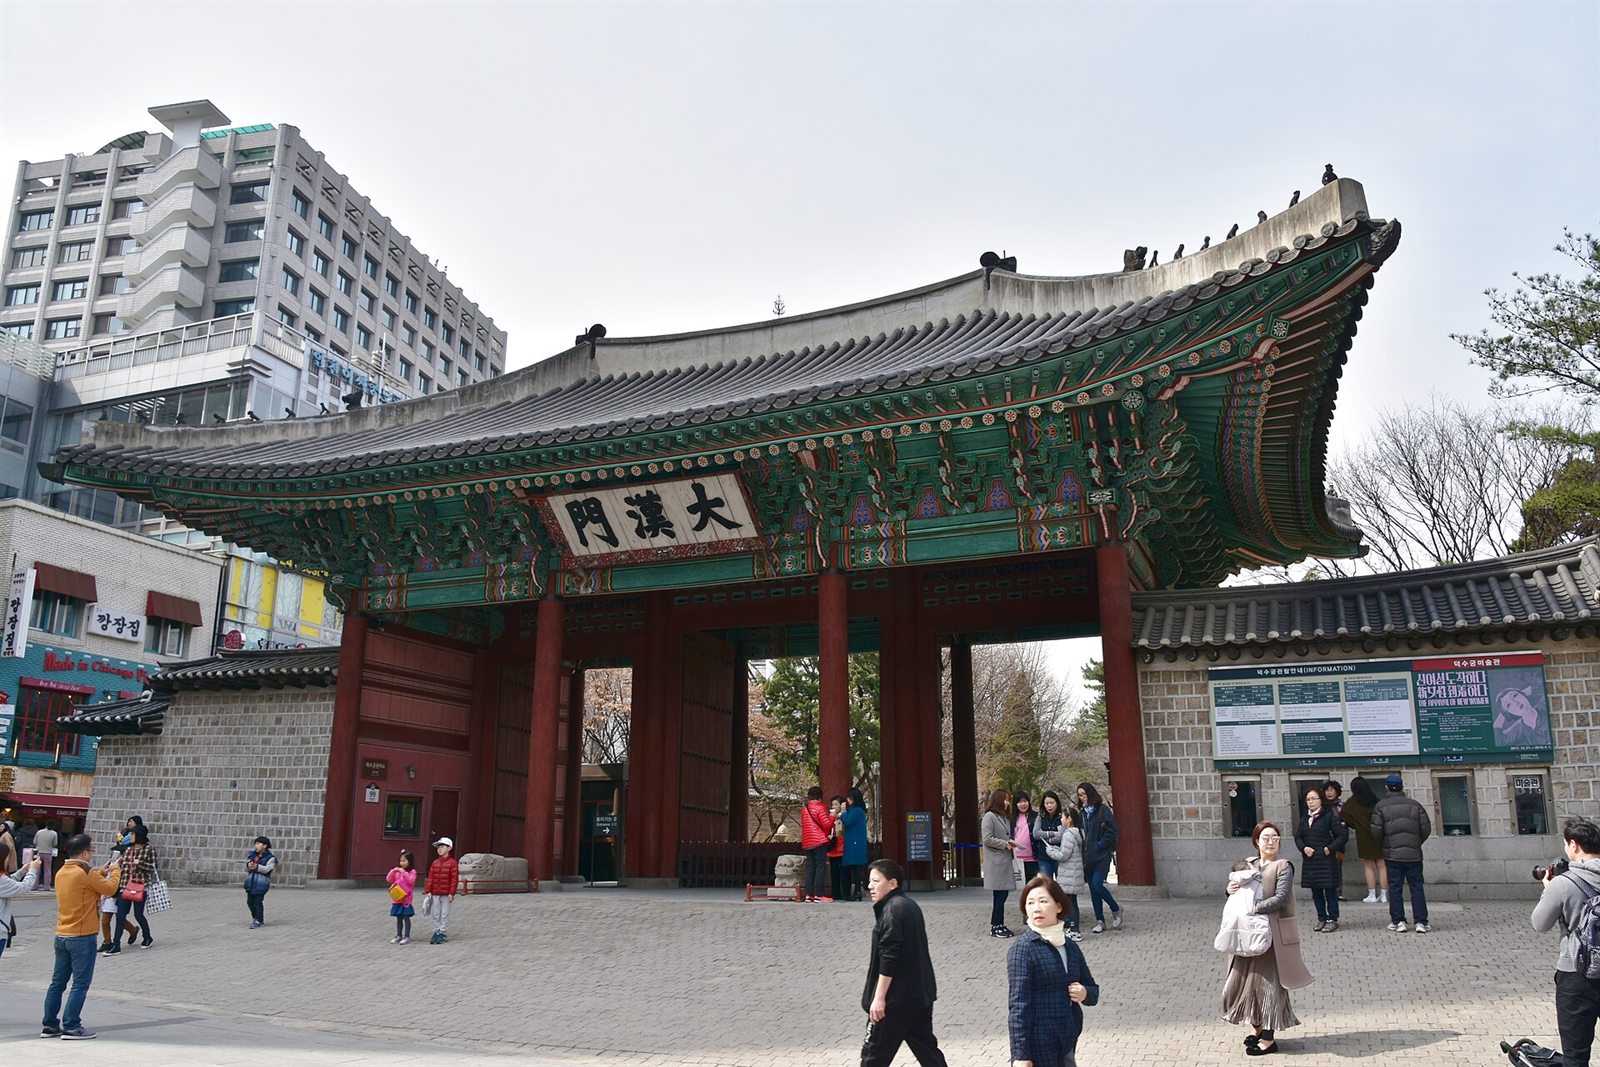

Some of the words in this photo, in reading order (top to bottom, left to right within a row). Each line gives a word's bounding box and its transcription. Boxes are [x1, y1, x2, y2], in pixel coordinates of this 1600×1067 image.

[565, 482, 743, 548] 大漢門
[97, 612, 141, 638] 깡장집
[45, 652, 75, 672] Made
[78, 659, 89, 672] in
[1453, 658, 1501, 667] 덕수궁미술관
[1515, 778, 1538, 788] 미술관
